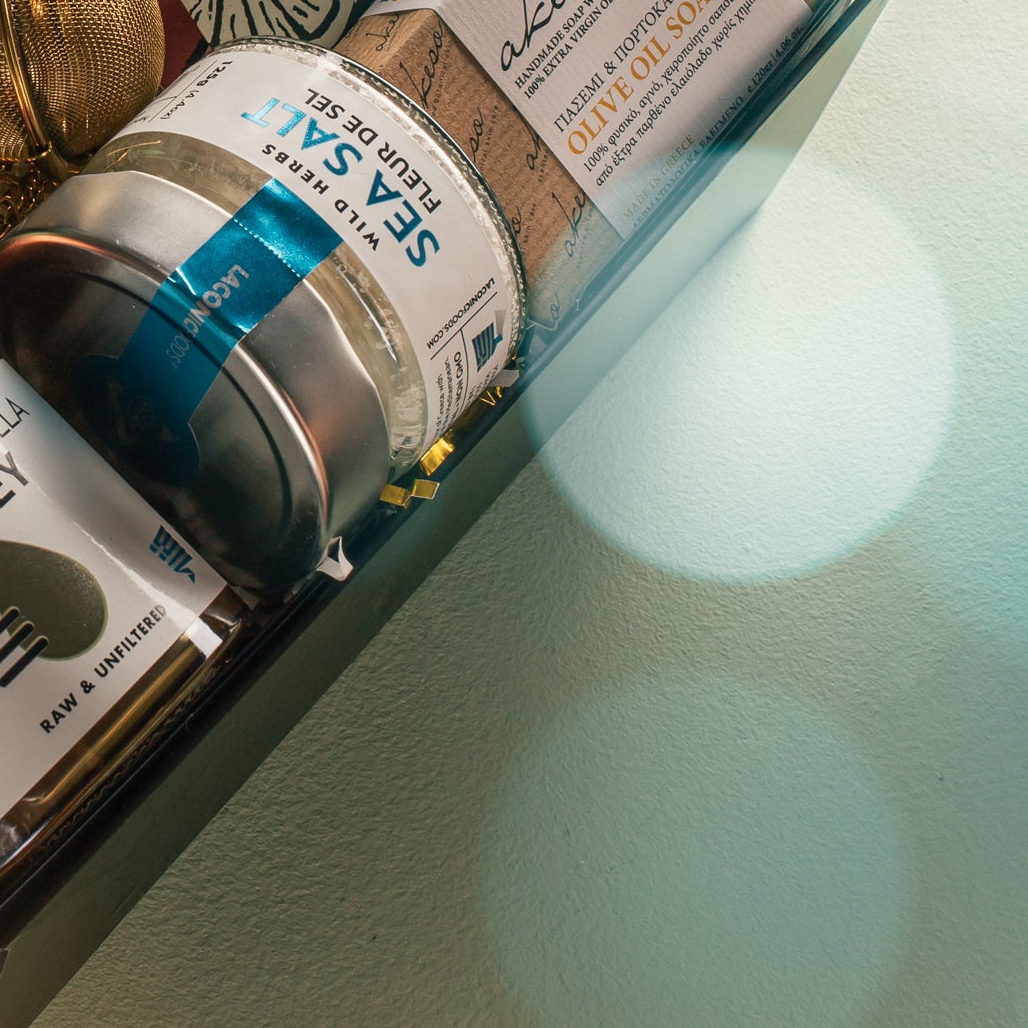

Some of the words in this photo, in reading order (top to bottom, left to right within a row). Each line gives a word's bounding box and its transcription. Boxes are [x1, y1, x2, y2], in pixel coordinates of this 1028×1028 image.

[514, 29, 565, 90] HANDMADE
[562, 5, 585, 34] SOAP
[523, 74, 546, 100] 100%
[542, 43, 573, 77] EXTRA
[569, 6, 602, 43] VIRGIN
[304, 88, 346, 120] SEL
[341, 114, 379, 147] DE
[553, 72, 605, 133] ΓΙΑΣΕΜΙ
[603, 60, 618, 75] &
[567, 75, 635, 155] OLIVE
[629, 36, 671, 81] OIL
[583, 143, 609, 173] 100%
[607, 108, 641, 147] φυσικό,
[639, 80, 664, 109] αγνό,
[660, 24, 710, 85] χειροποίητο
[596, 163, 614, 187] από
[611, 136, 638, 167] έξτρα
[635, 95, 672, 139] παρθένο
[670, 46, 713, 97] ελαιόλαδο
[710, 18, 737, 52] χωρίς
[240, 98, 363, 176] SALT
[261, 144, 330, 195] HERBS
[648, 178, 662, 190] IN
[660, 131, 695, 176] GREECE
[377, 141, 442, 214] FLEUR
[334, 199, 380, 252] WILD
[365, 169, 440, 267] SEA
[426, 277, 495, 350] LACONICFOODS.COM
[453, 350, 464, 380] GMO
[39, 692, 78, 734] RAW
[79, 680, 96, 694] &
[93, 607, 164, 678] UNFILTERED
